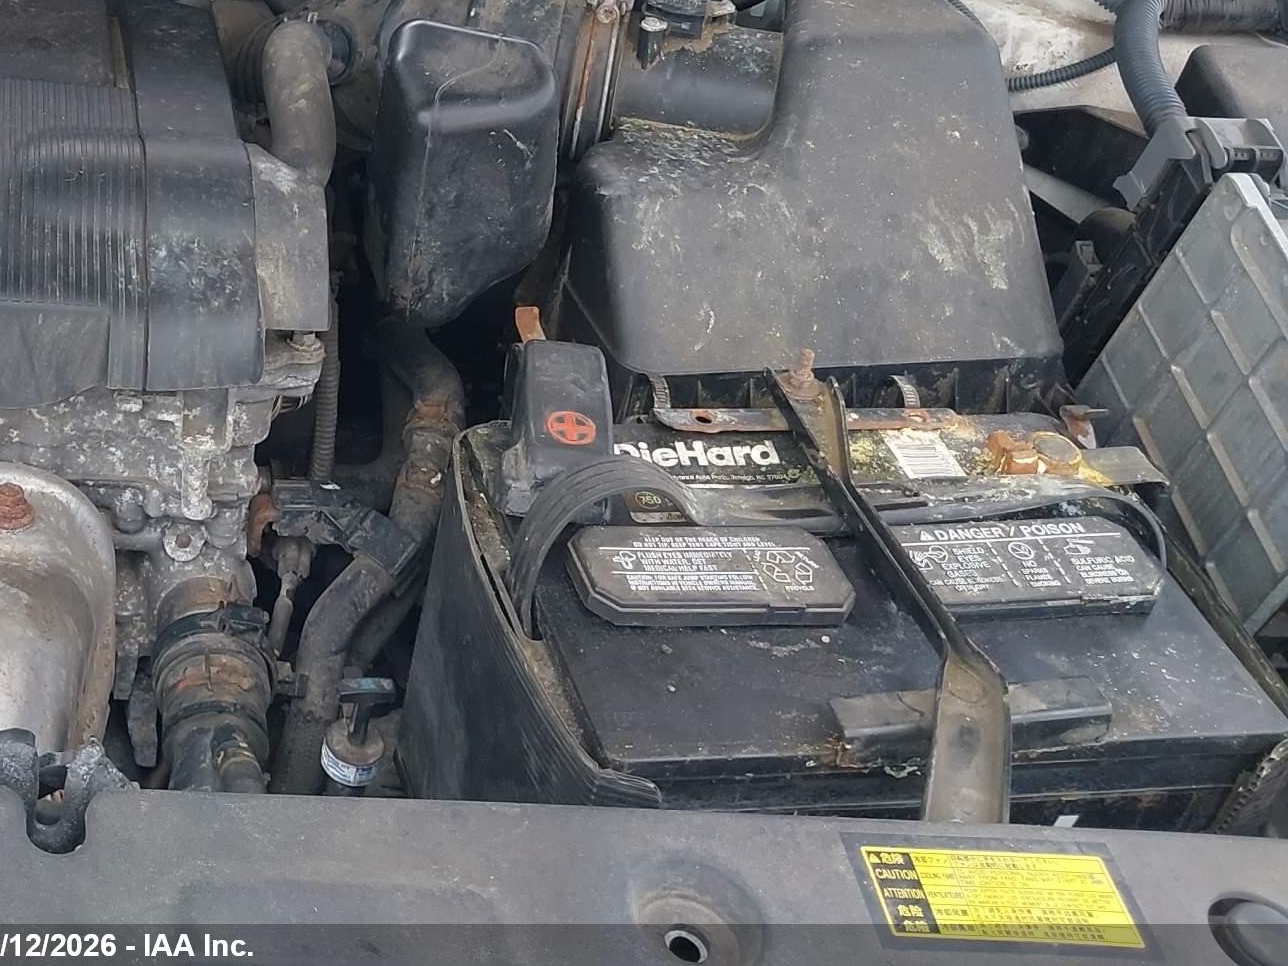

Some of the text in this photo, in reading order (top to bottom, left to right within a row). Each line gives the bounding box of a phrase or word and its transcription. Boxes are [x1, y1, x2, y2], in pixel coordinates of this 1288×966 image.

[934, 527, 1006, 540] DANGER
[1019, 523, 1085, 538] POISON
[953, 547, 984, 555] SHIELD
[958, 555, 983, 563] EYES
[1071, 555, 1135, 565] SULFURIC ACID
[942, 561, 991, 571] EXPLOSIVE
[946, 570, 978, 578] GASES
[875, 868, 919, 880] CAUTION
[884, 887, 926, 899] ATTENTION
